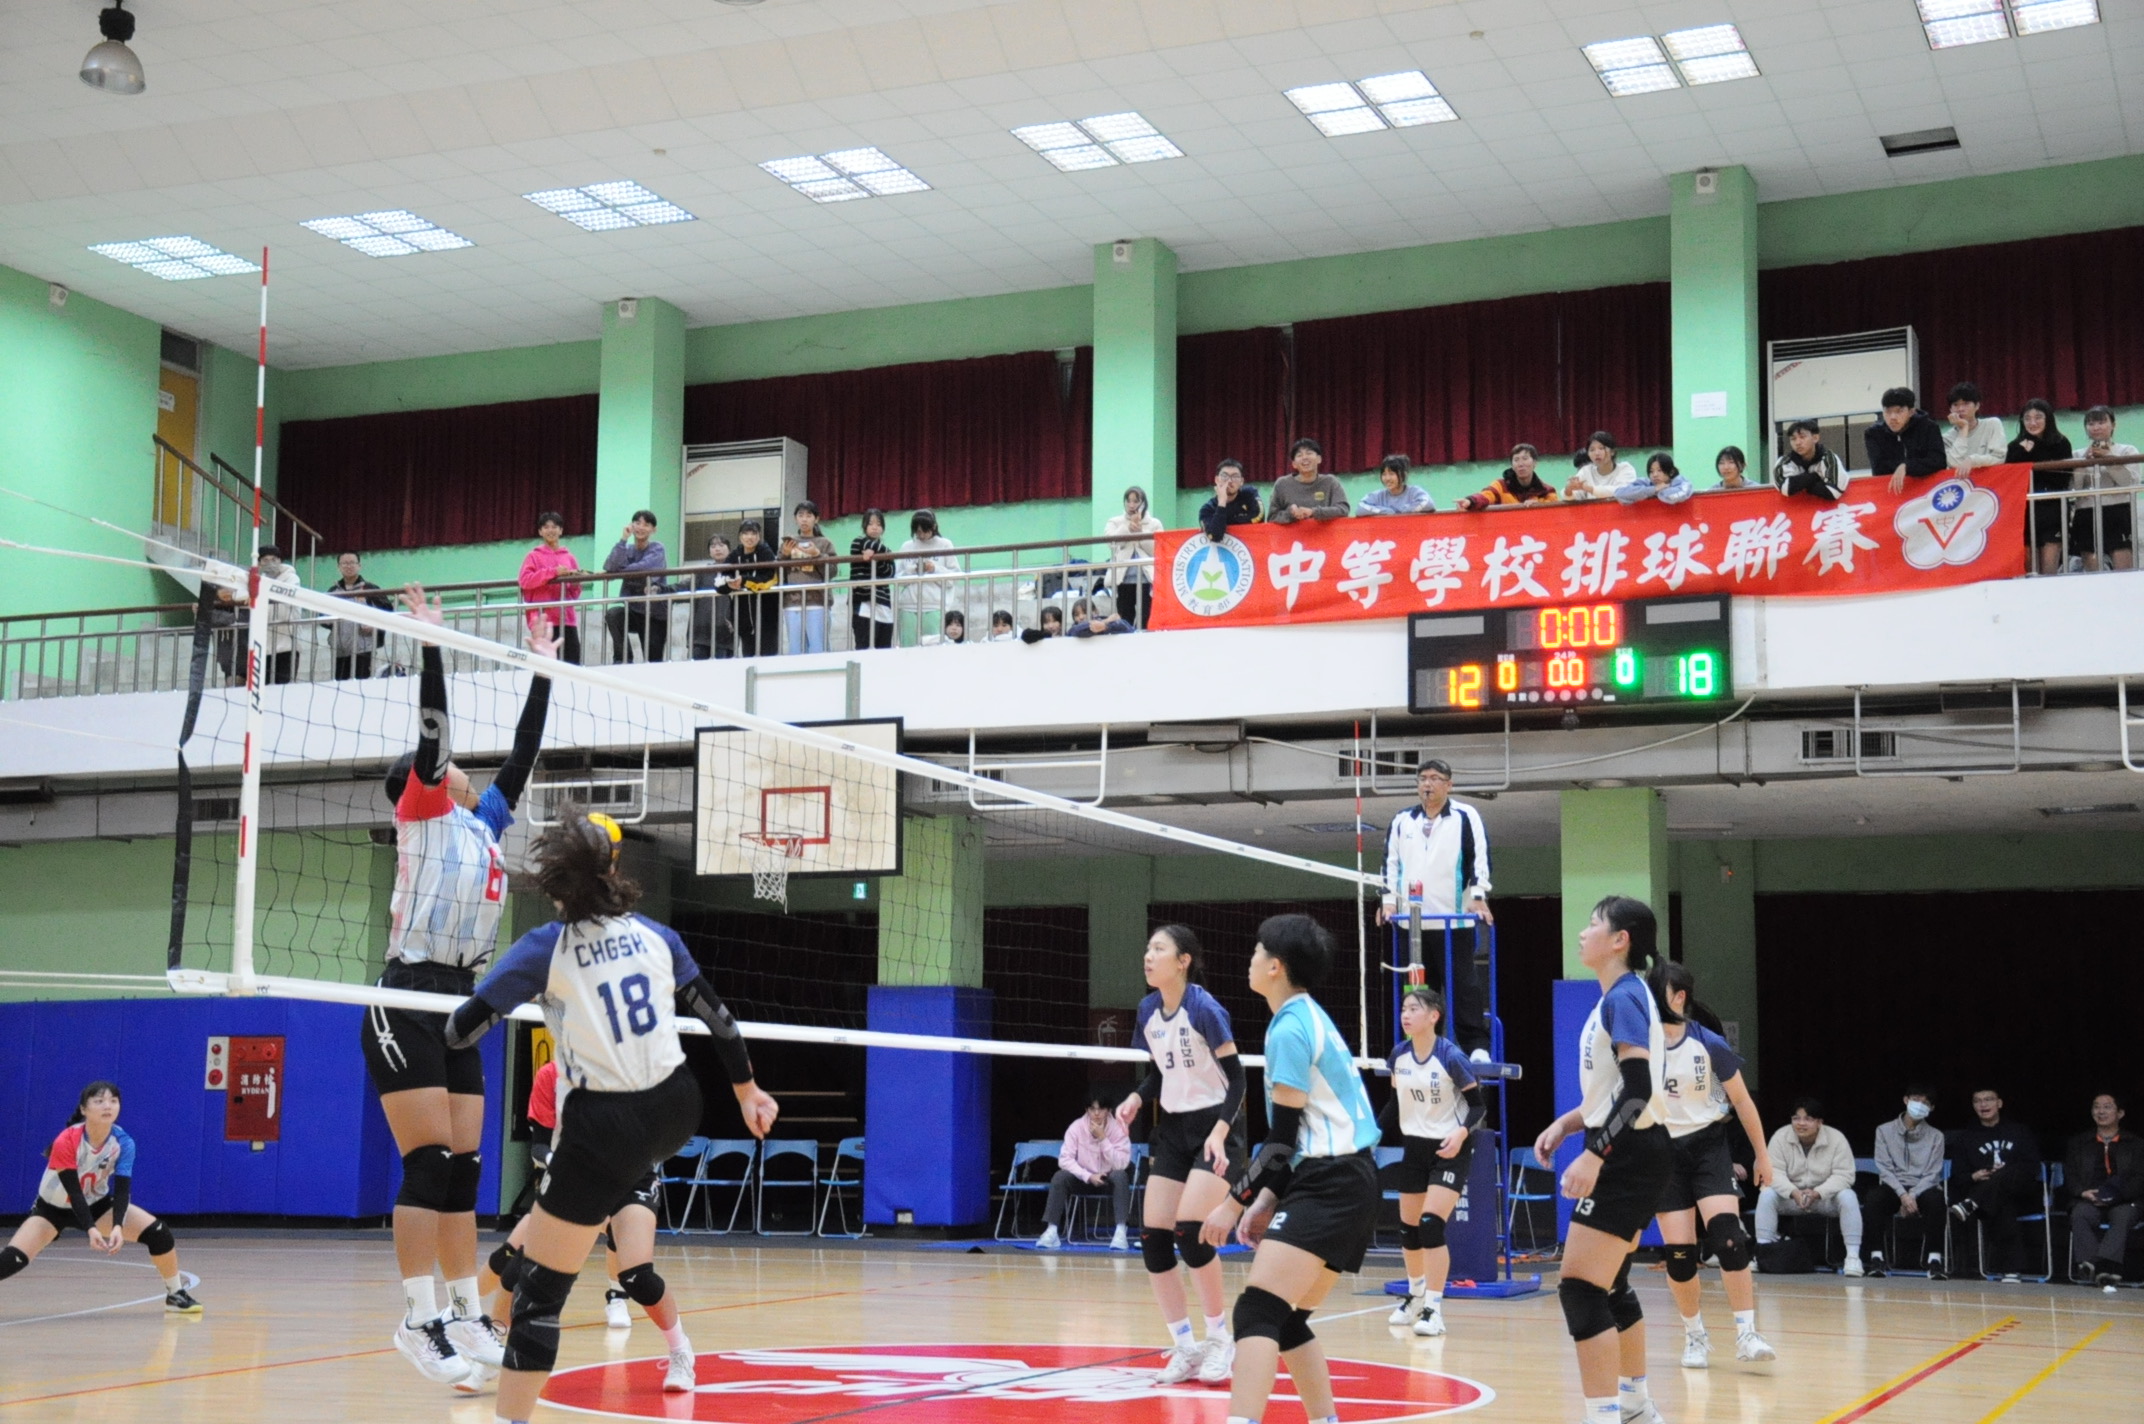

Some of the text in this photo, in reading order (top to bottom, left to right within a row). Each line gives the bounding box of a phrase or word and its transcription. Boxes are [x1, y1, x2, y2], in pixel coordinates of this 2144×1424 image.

[1175, 540, 1198, 597] MINISTRY
[1267, 501, 1879, 611] 中等學校排球聯賽
[269, 584, 297, 598] conti
[1188, 598, 1230, 615] 教育部
[1540, 604, 1616, 649] 0:00
[507, 650, 528, 662] conti
[1615, 654, 1635, 685] 0
[250, 639, 263, 715] conti
[1448, 664, 1481, 707] 12
[1497, 661, 1517, 691] 0
[1548, 658, 1584, 687] 0.0
[1679, 652, 1713, 696] 18
[574, 932, 648, 968] CHGSH
[597, 973, 658, 1044] 18
[1165, 1051, 1175, 1070] 3
[1410, 1088, 1425, 1102] 10
[1979, 1140, 2014, 1155] EDWIN
[1442, 1170, 1456, 1184] 10
[1575, 1196, 1595, 1216] 13
